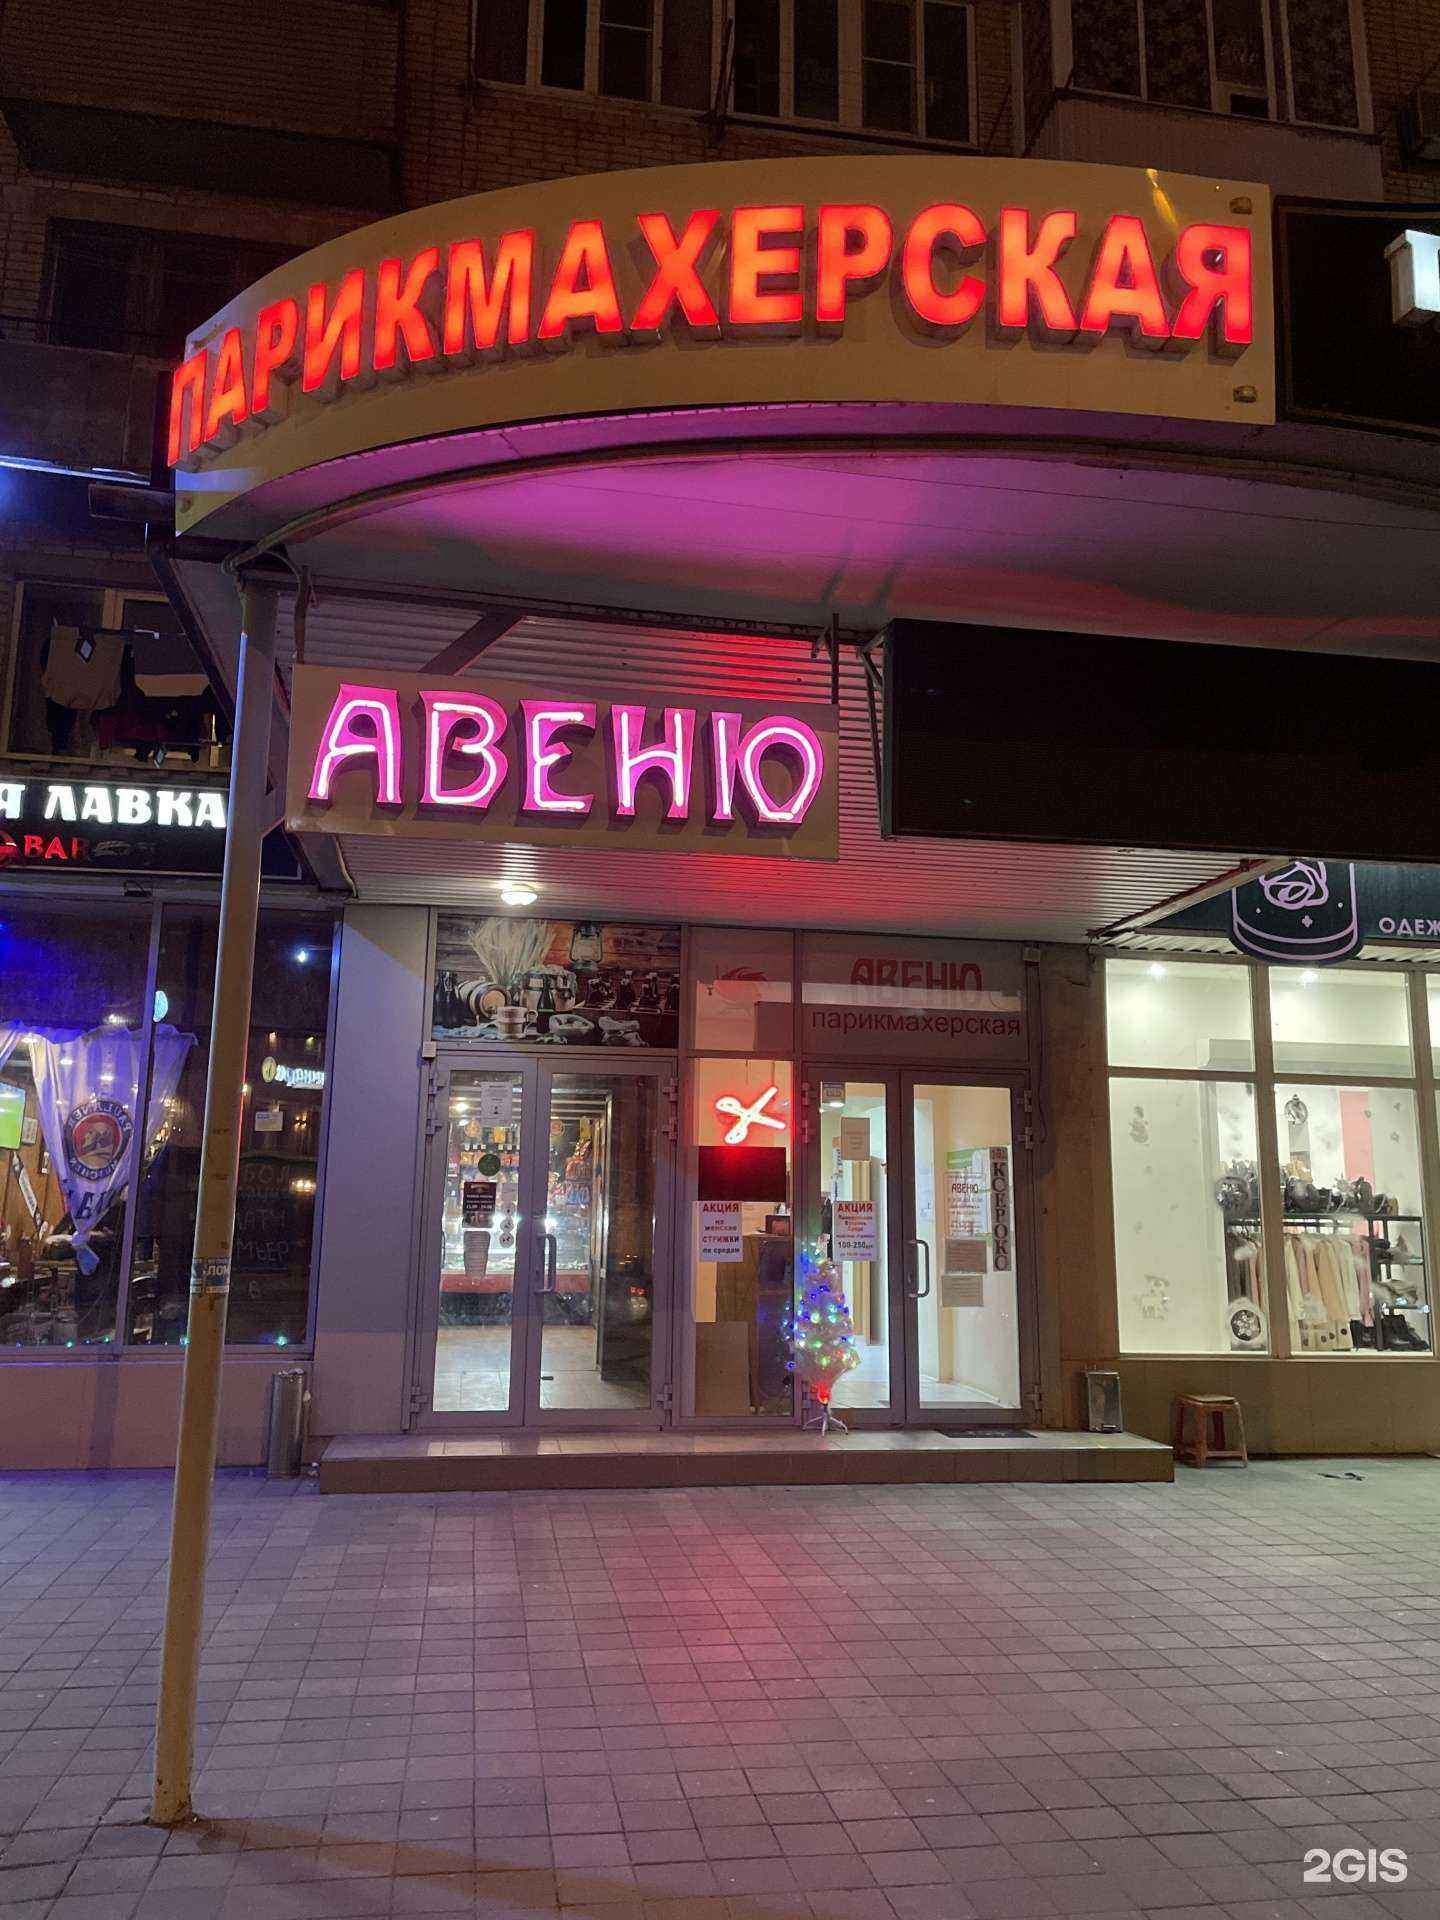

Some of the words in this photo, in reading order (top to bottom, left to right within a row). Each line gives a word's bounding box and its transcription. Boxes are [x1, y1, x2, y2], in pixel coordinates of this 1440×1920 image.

[167, 202, 1254, 468] ПАРИКМАХЕРСКАЯ
[307, 683, 825, 824] АВЕНЮ
[44, 785, 228, 829] ЛАВКА
[851, 958, 985, 998] АВЕНЮ
[811, 1010, 1021, 1038] парикмахерская
[951, 1183, 979, 1194] АВЕНЮ
[703, 1202, 739, 1215] АКЦИЯ
[837, 1202, 873, 1214] АКЦИЯ
